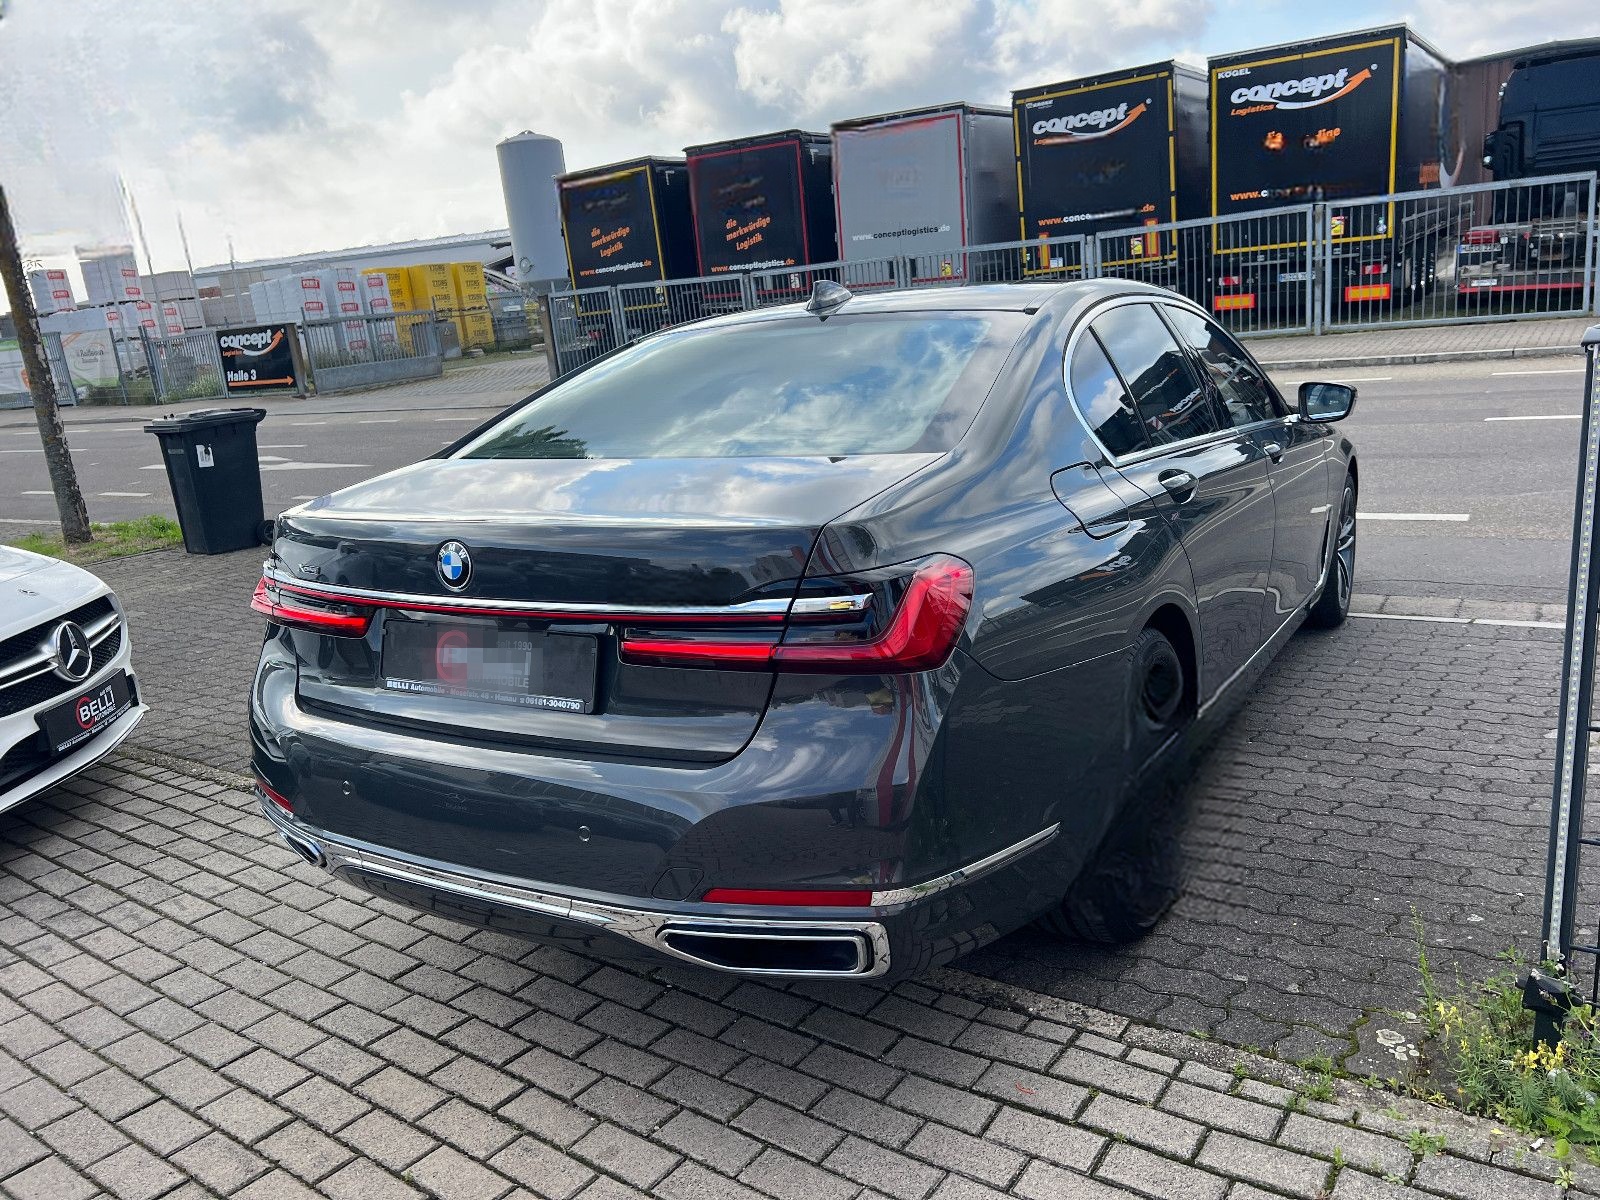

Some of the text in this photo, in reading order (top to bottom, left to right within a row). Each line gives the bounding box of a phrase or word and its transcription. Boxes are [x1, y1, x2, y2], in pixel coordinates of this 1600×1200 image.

[1231, 67, 1348, 104] concept
[1231, 104, 1275, 116] Logistics
[1033, 102, 1128, 135] concept
[726, 218, 737, 229] die
[726, 216, 771, 241] merkwürdige
[852, 224, 951, 240] www.conceptlogistics.de
[736, 233, 762, 250] Logistik
[580, 259, 652, 276] www.conceptlogistics.de
[711, 258, 795, 272] www.conceptlogistics.de
[220, 329, 272, 348] concept
[227, 369, 257, 381] Halle 3
[439, 543, 467, 559] BMW
[513, 641, 533, 651] 1990
[410, 683, 445, 694] Automobile
[79, 689, 115, 722] BELLI
